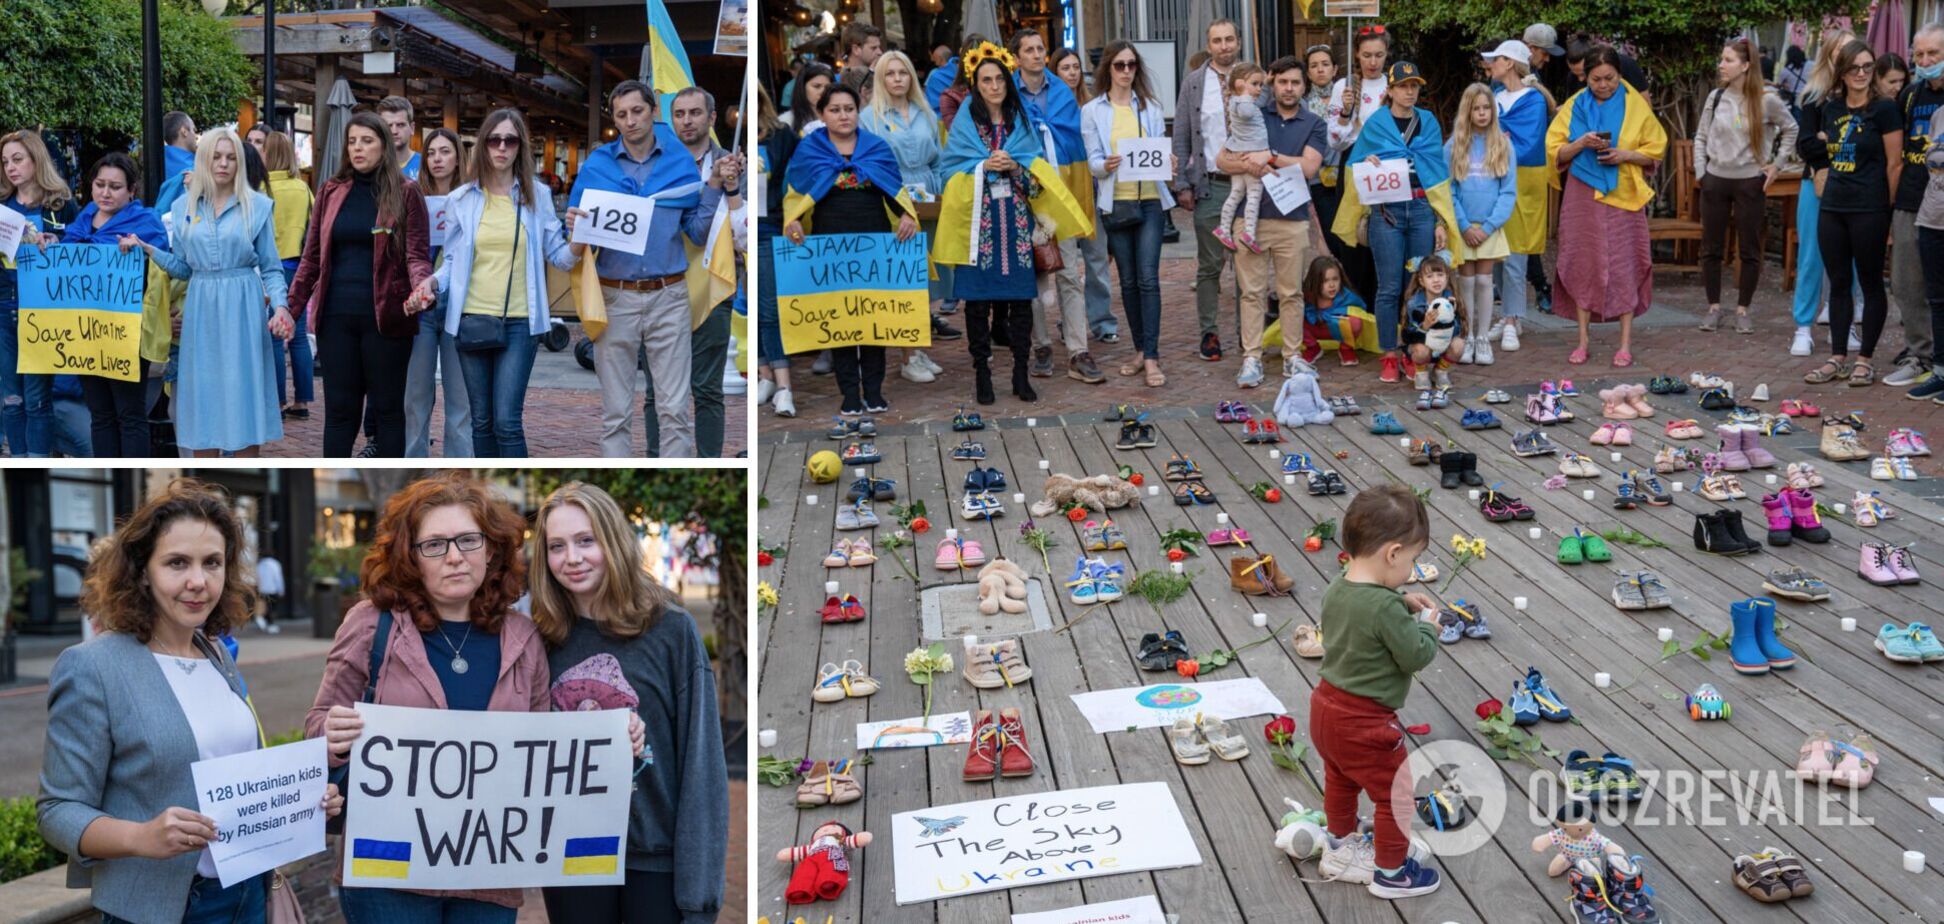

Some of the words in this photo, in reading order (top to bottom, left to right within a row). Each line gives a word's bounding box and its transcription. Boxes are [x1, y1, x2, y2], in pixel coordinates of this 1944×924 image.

[1126, 150, 1163, 169] 128
[1362, 172, 1401, 192] 128
[588, 205, 638, 236] 128
[106, 246, 142, 272] WITH
[884, 235, 924, 256] WITH
[790, 298, 840, 327] Save
[27, 312, 75, 344] Save
[818, 322, 863, 344] Save
[873, 323, 920, 343] Lives
[54, 342, 96, 370] Save
[101, 350, 131, 376] Lives
[359, 735, 498, 800] STOP
[513, 738, 612, 797] THE
[206, 784, 234, 804] 128
[236, 774, 296, 797] Ukrainian
[299, 766, 322, 782] kids
[237, 802, 268, 818] were
[270, 790, 301, 809] killed
[993, 797, 1117, 828] Close
[217, 829, 234, 845] by
[237, 816, 287, 838] Russian
[289, 807, 316, 824] army
[415, 807, 555, 867] WAR!
[915, 836, 1006, 859] The
[999, 843, 1095, 865] Above
[937, 854, 1120, 893] Ukraine
[1108, 913, 1132, 922] kids
